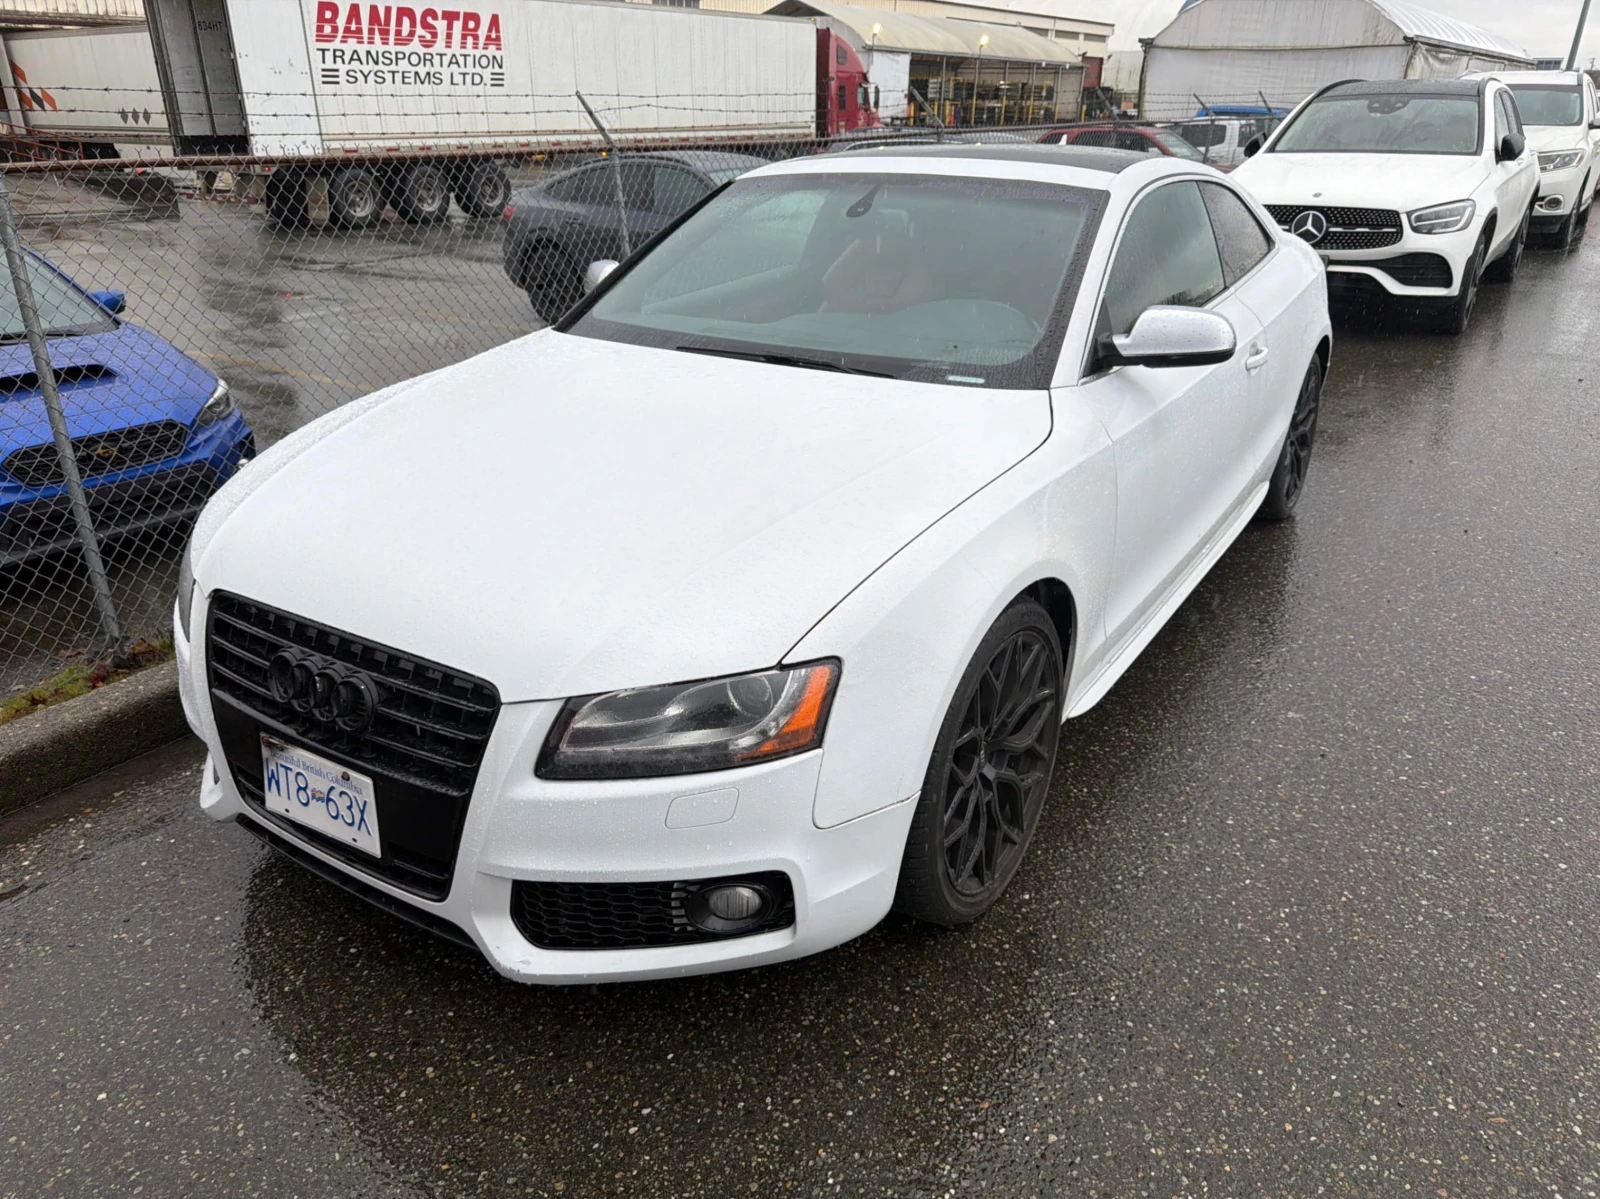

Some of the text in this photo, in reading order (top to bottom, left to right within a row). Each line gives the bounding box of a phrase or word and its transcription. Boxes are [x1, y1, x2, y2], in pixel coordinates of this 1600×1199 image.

[315, 1, 502, 51] BANDSTRA
[316, 48, 504, 70] TRANSPORTATION
[345, 69, 488, 87] SYSTEMS LTD.
[302, 760, 326, 779] British
[326, 771, 362, 795] Columbia
[265, 757, 372, 836] WT8 63X
